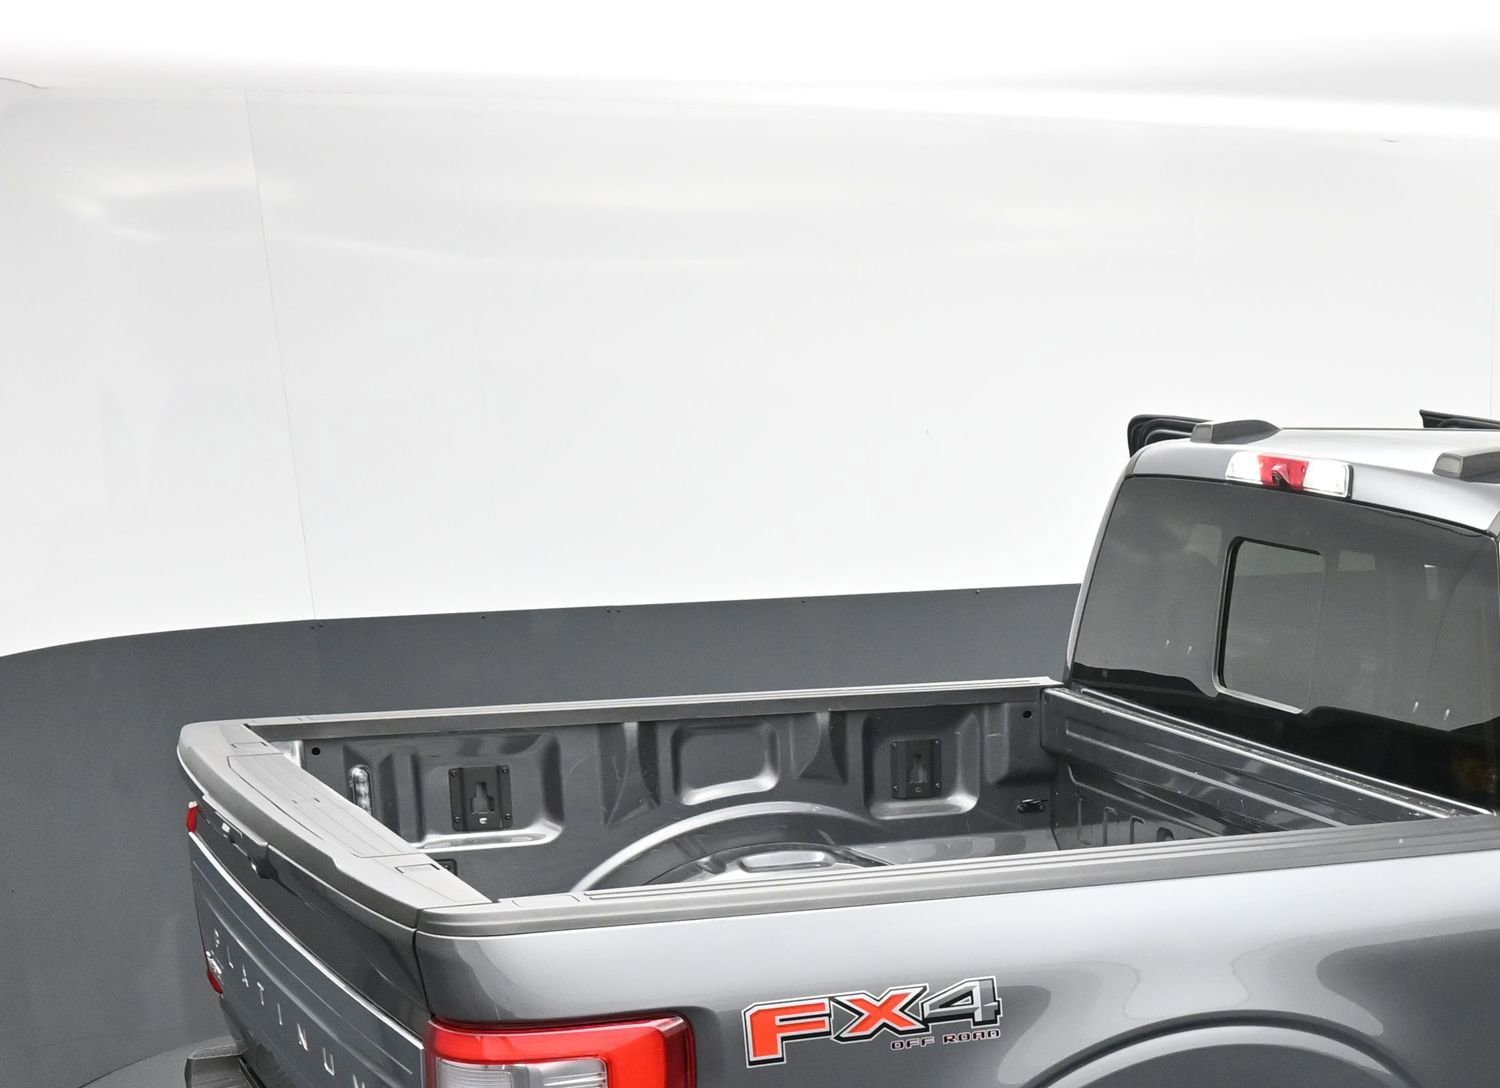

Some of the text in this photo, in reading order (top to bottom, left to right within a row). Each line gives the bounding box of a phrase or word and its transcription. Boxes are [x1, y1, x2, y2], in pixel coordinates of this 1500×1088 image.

[742, 977, 1002, 1068] FX4
[890, 1029, 1001, 1051] OFF ROAD
